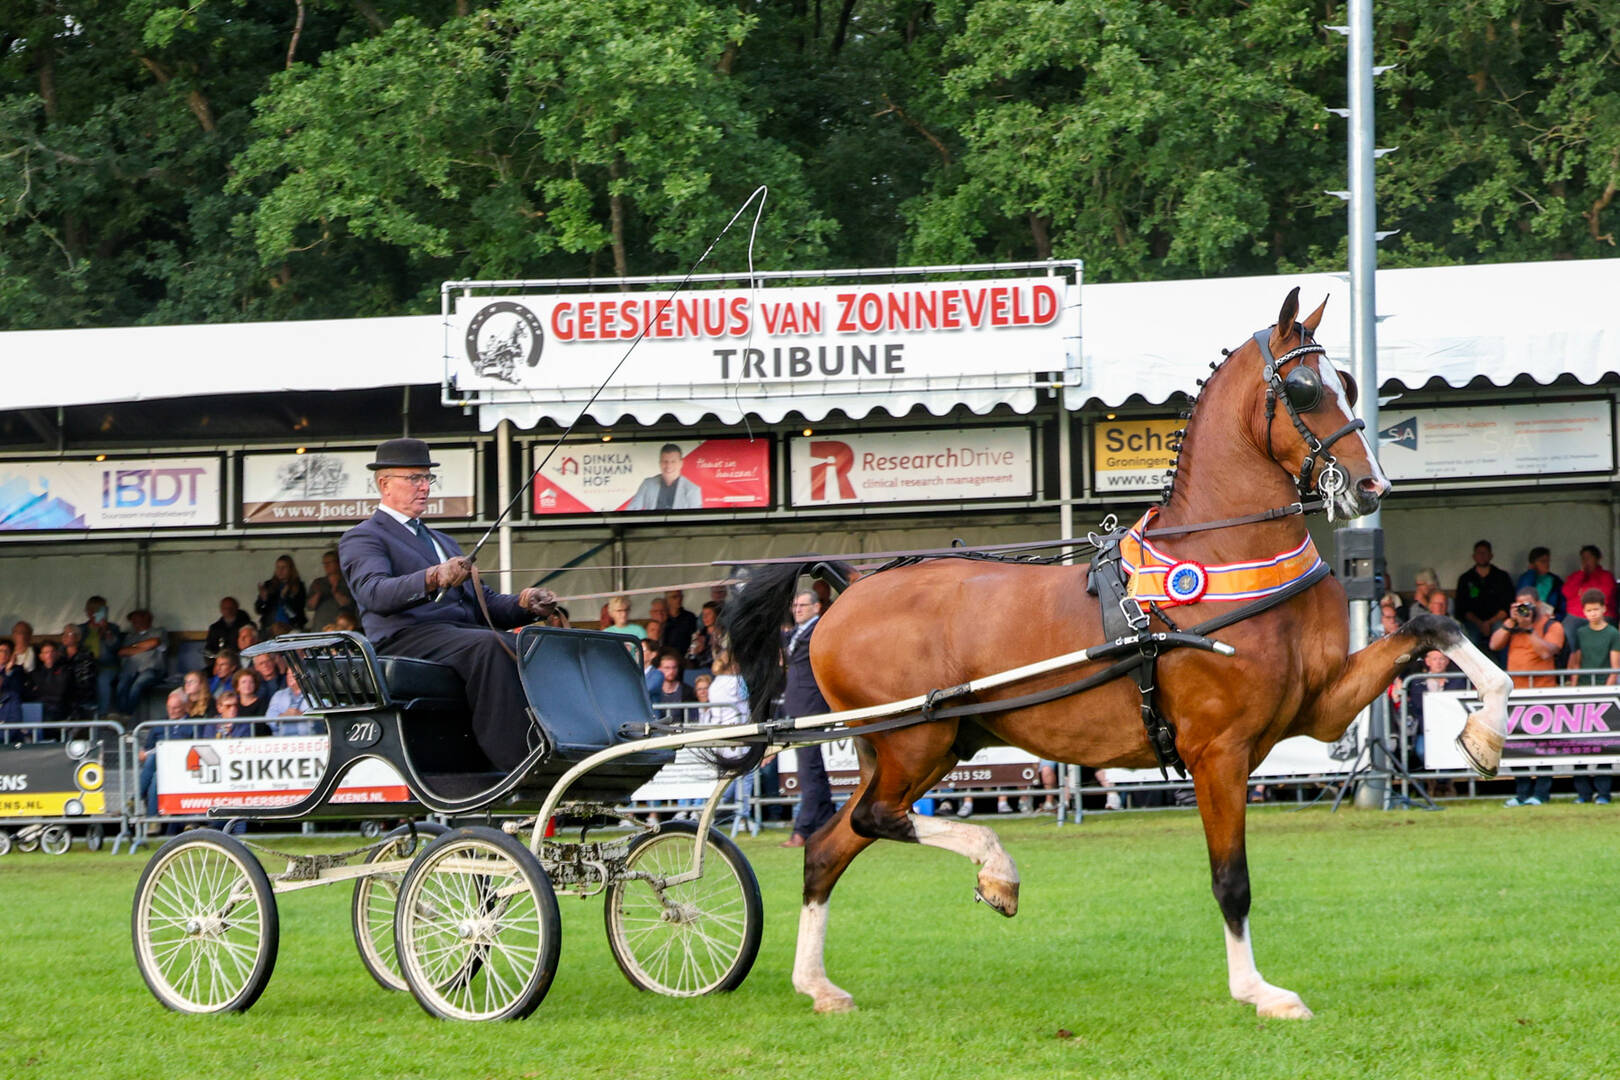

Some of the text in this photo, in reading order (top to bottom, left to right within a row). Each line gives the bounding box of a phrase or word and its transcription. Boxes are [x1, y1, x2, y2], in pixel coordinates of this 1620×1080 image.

[551, 285, 1057, 341] GEESIENUS VAN ZONNEVELD
[713, 344, 906, 379] TRIBUNE
[583, 454, 632, 465] DINKLA
[862, 447, 1014, 471] ResearchDrive
[1106, 456, 1168, 468] Groningen
[583, 464, 633, 475] NUMAN
[102, 467, 207, 508] IBDT
[583, 476, 610, 487] HOF
[862, 474, 1013, 489] clinical research management
[348, 722, 375, 741] 271
